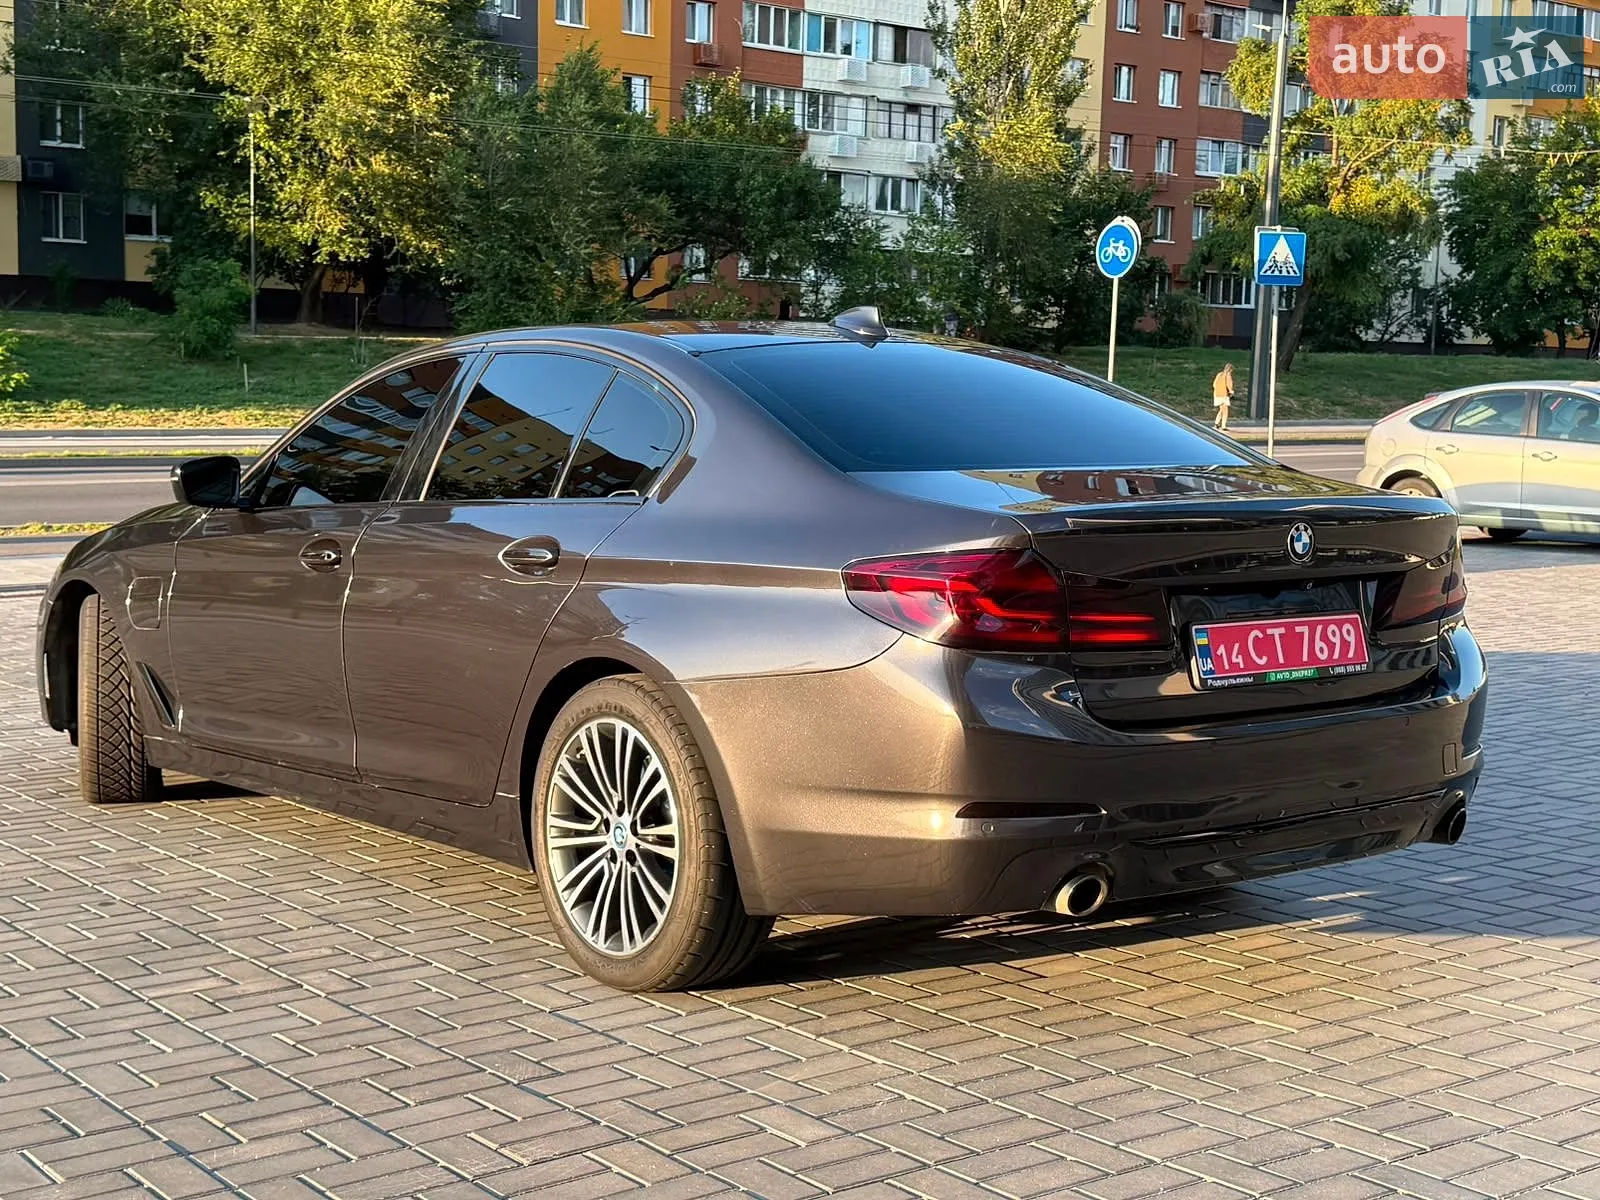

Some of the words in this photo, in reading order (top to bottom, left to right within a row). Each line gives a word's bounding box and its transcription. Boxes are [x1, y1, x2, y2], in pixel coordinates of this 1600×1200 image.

[1216, 642, 1245, 670] 14
[1247, 627, 1286, 666] CT
[1295, 623, 1357, 663] 7699
[1199, 657, 1215, 672] UA
